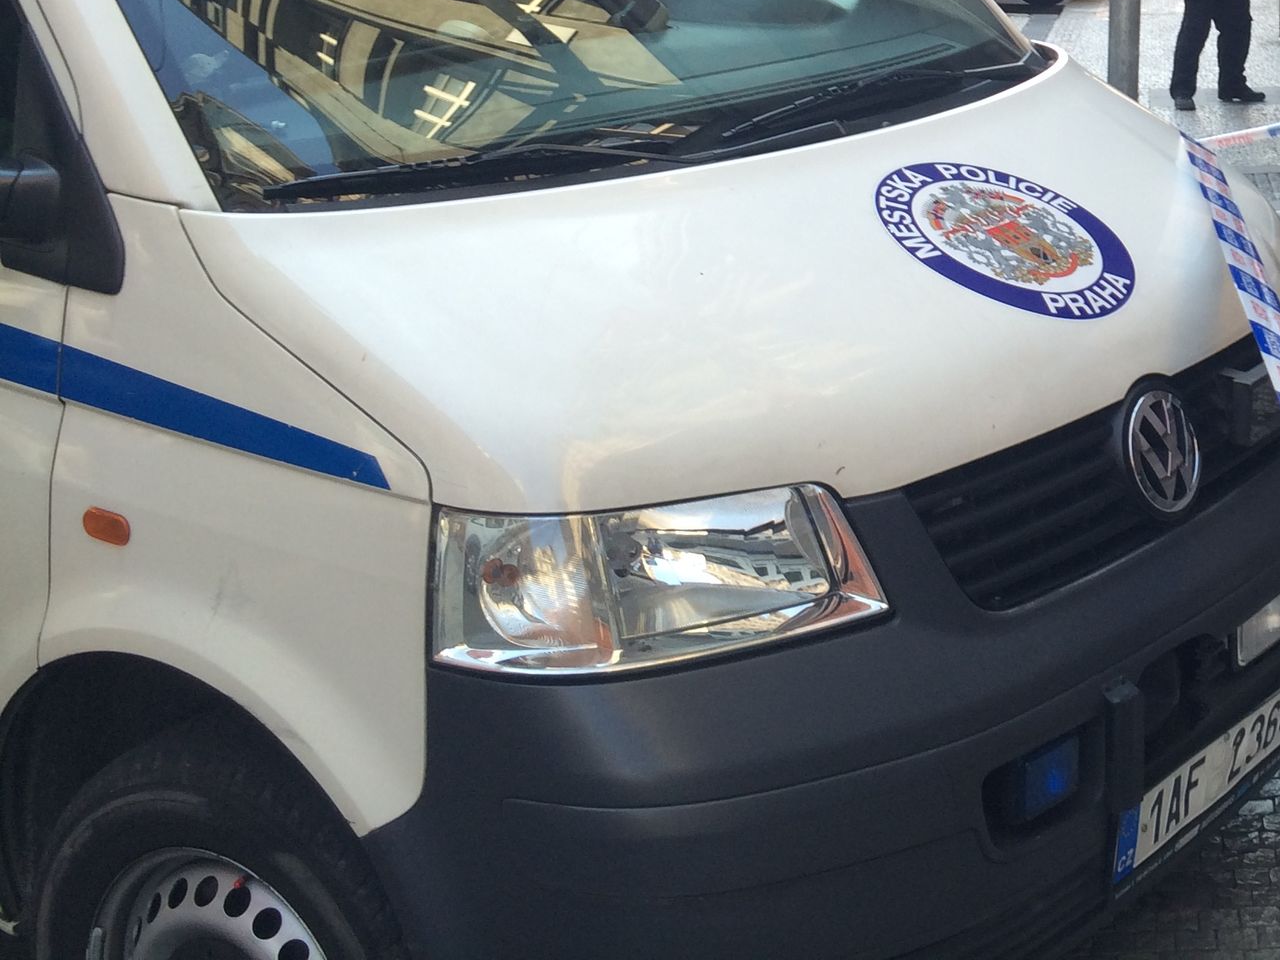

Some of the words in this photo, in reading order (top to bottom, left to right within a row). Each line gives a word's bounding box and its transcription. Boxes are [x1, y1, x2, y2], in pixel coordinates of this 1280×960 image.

[934, 163, 1079, 215] POLICIE
[1041, 271, 1132, 317] PRAHA
[1150, 755, 1206, 845] 1AF
[1116, 848, 1135, 874] CZ
